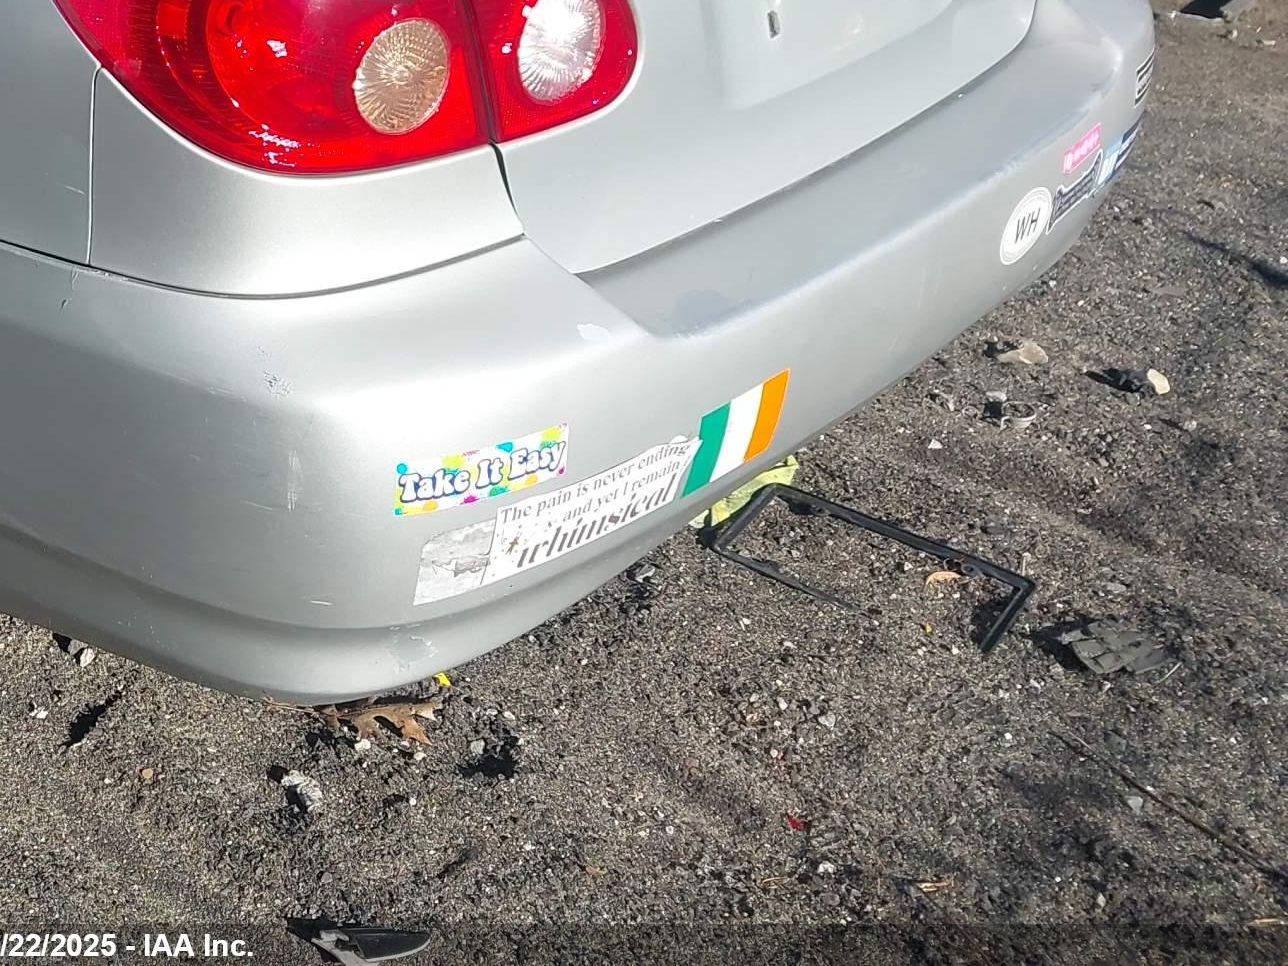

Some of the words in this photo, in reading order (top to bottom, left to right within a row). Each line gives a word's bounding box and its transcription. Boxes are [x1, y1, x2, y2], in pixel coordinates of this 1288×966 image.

[1014, 207, 1041, 244] WH
[398, 468, 471, 503] Take
[475, 457, 504, 489] It
[507, 440, 566, 480] Easy
[500, 505, 532, 524] The
[536, 490, 571, 517] pain
[576, 484, 589, 498] is
[593, 463, 634, 491] never
[638, 445, 690, 470] ending
[562, 498, 593, 522] and
[594, 487, 619, 513] yet
[631, 461, 681, 492] remain
[517, 472, 677, 568] whimsical
